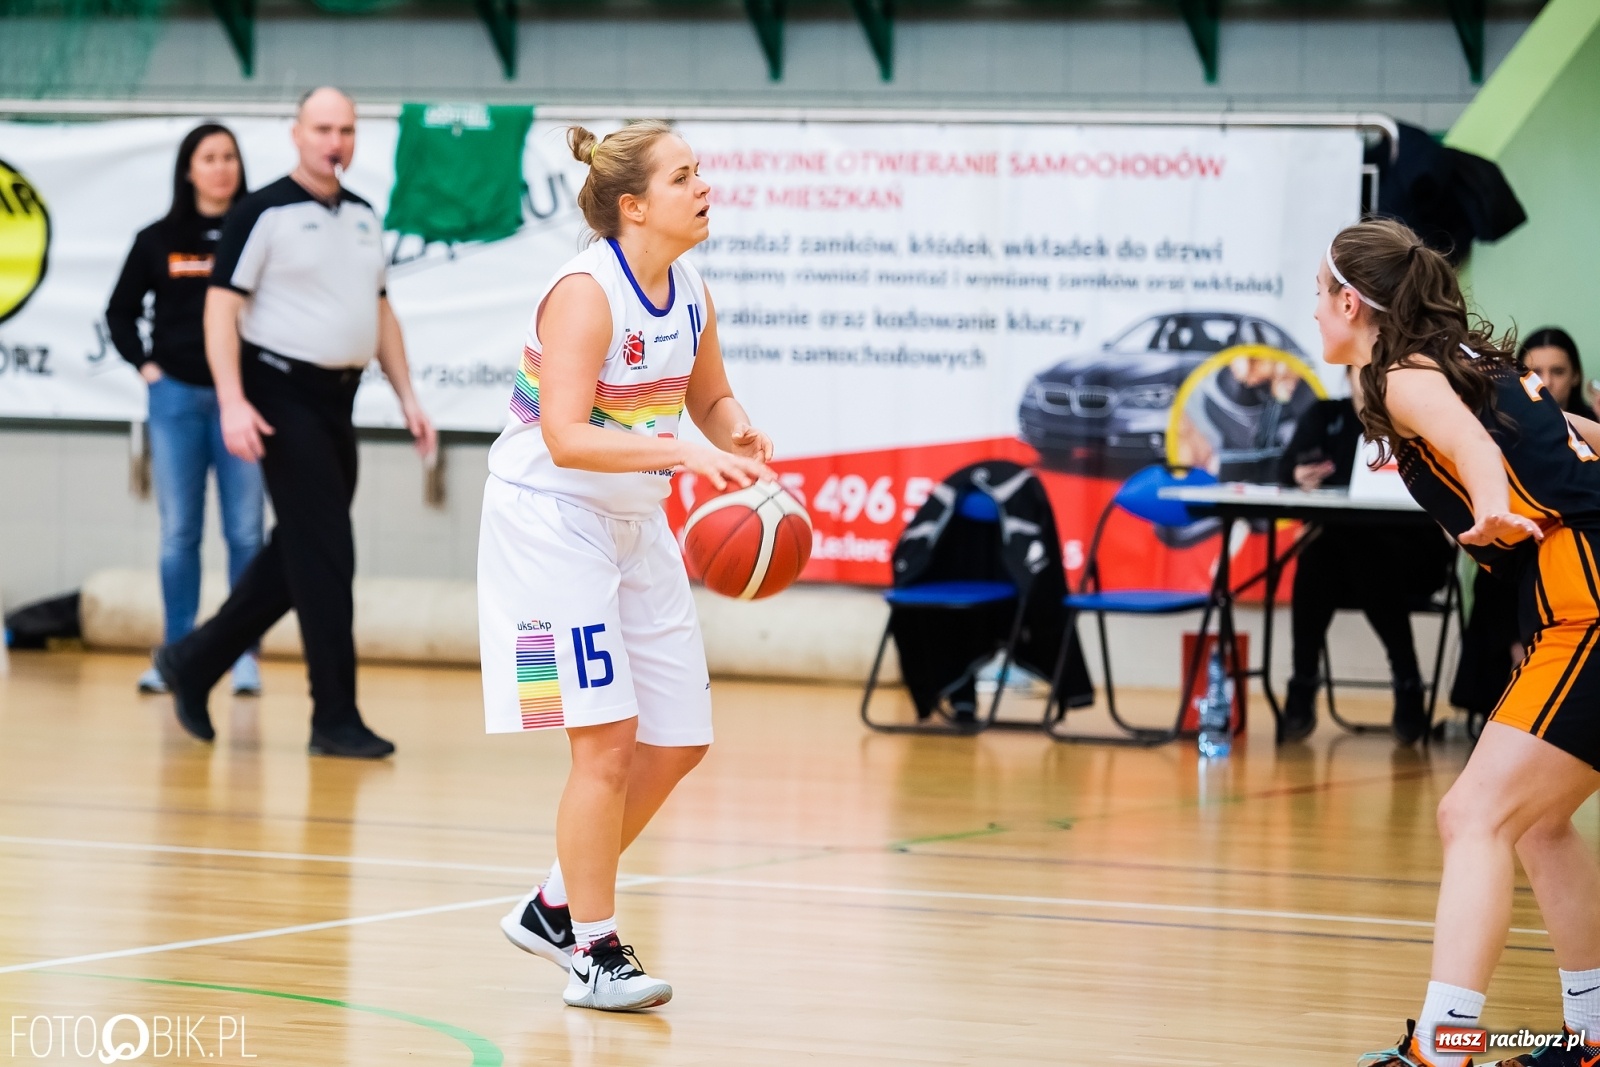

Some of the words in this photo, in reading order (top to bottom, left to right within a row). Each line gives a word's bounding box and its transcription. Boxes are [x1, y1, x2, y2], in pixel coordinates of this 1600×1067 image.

[835, 152, 998, 177] OTWIERANIE
[1009, 149, 1224, 180] SAMOCHODÓW
[709, 186, 757, 208] RAZ
[767, 182, 904, 209] MIESZKAŃ
[697, 229, 791, 257] przedaż
[1116, 236, 1147, 262] do
[1155, 238, 1223, 263] drzwi
[1146, 275, 1185, 294] oraz
[716, 305, 809, 330] rabianie
[820, 310, 865, 331] oraz
[875, 306, 998, 332] kodowanie
[791, 343, 985, 372] samochodowych
[813, 474, 897, 525] 496
[571, 622, 615, 689] 15
